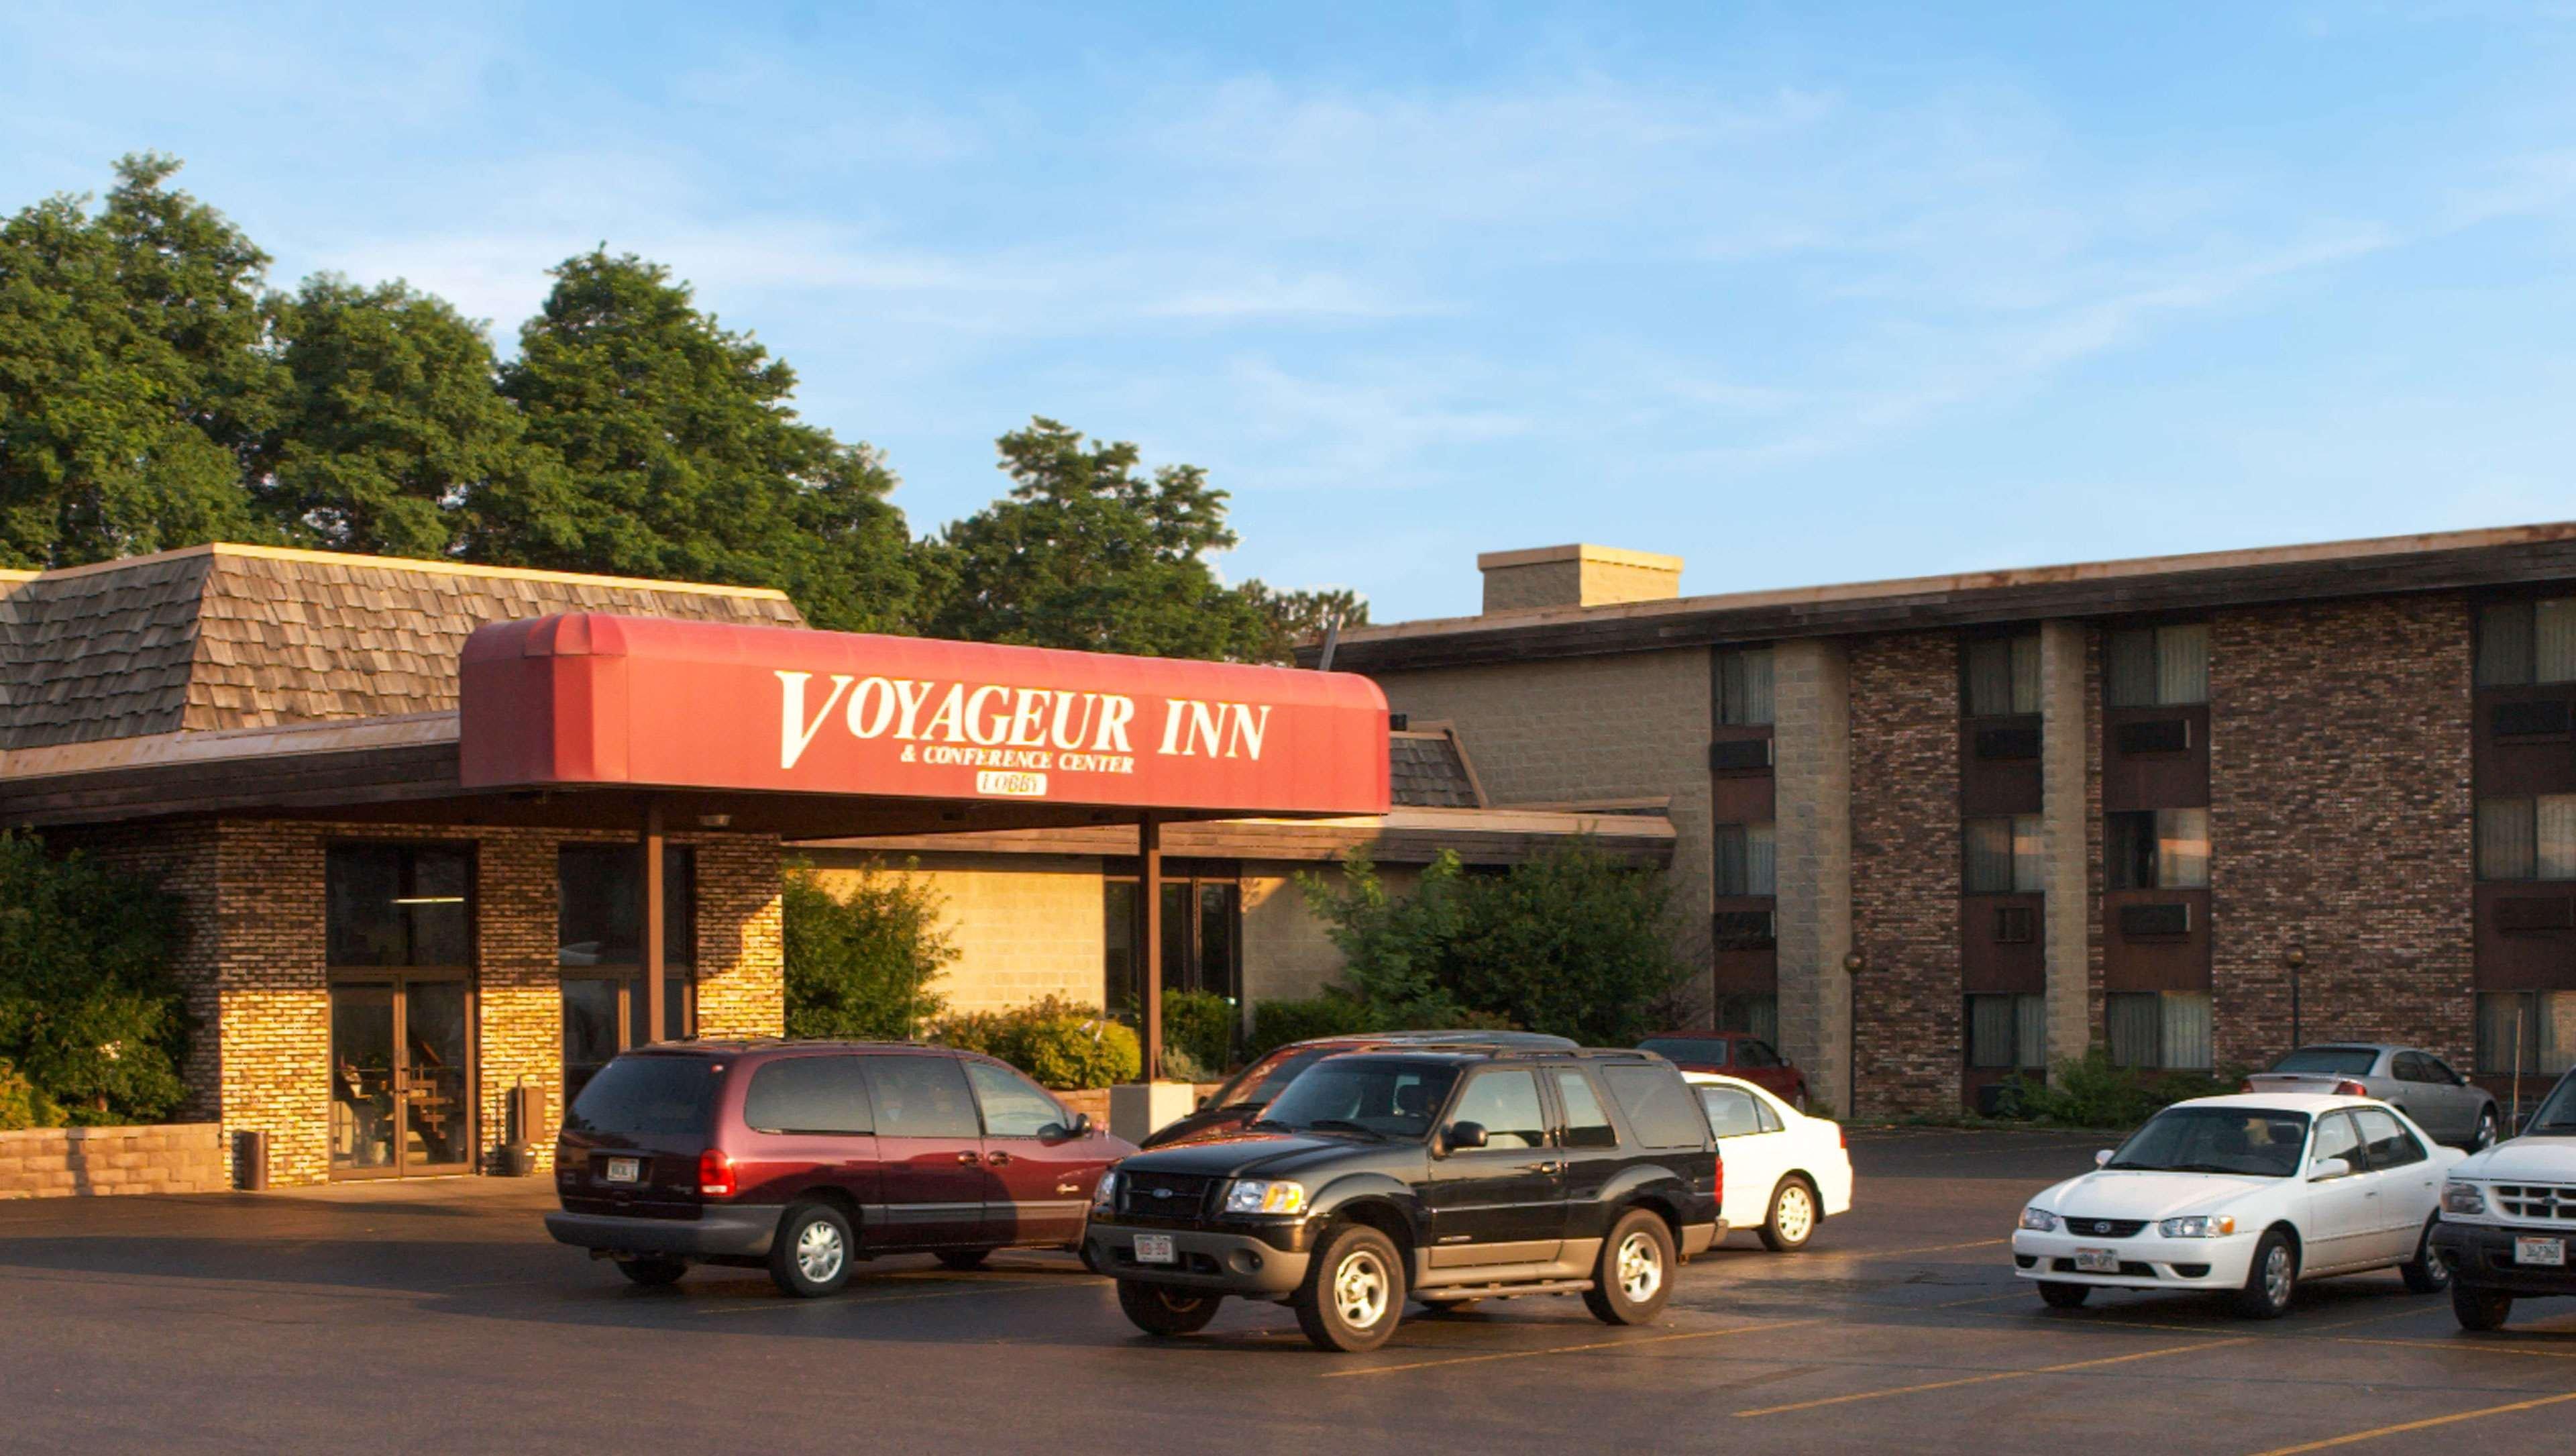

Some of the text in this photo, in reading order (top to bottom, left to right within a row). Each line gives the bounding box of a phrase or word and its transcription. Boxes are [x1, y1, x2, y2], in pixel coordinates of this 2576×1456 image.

[773, 670, 1271, 769] VOYAGEUR INN
[900, 744, 1134, 774] & CONFERENCE CENTER
